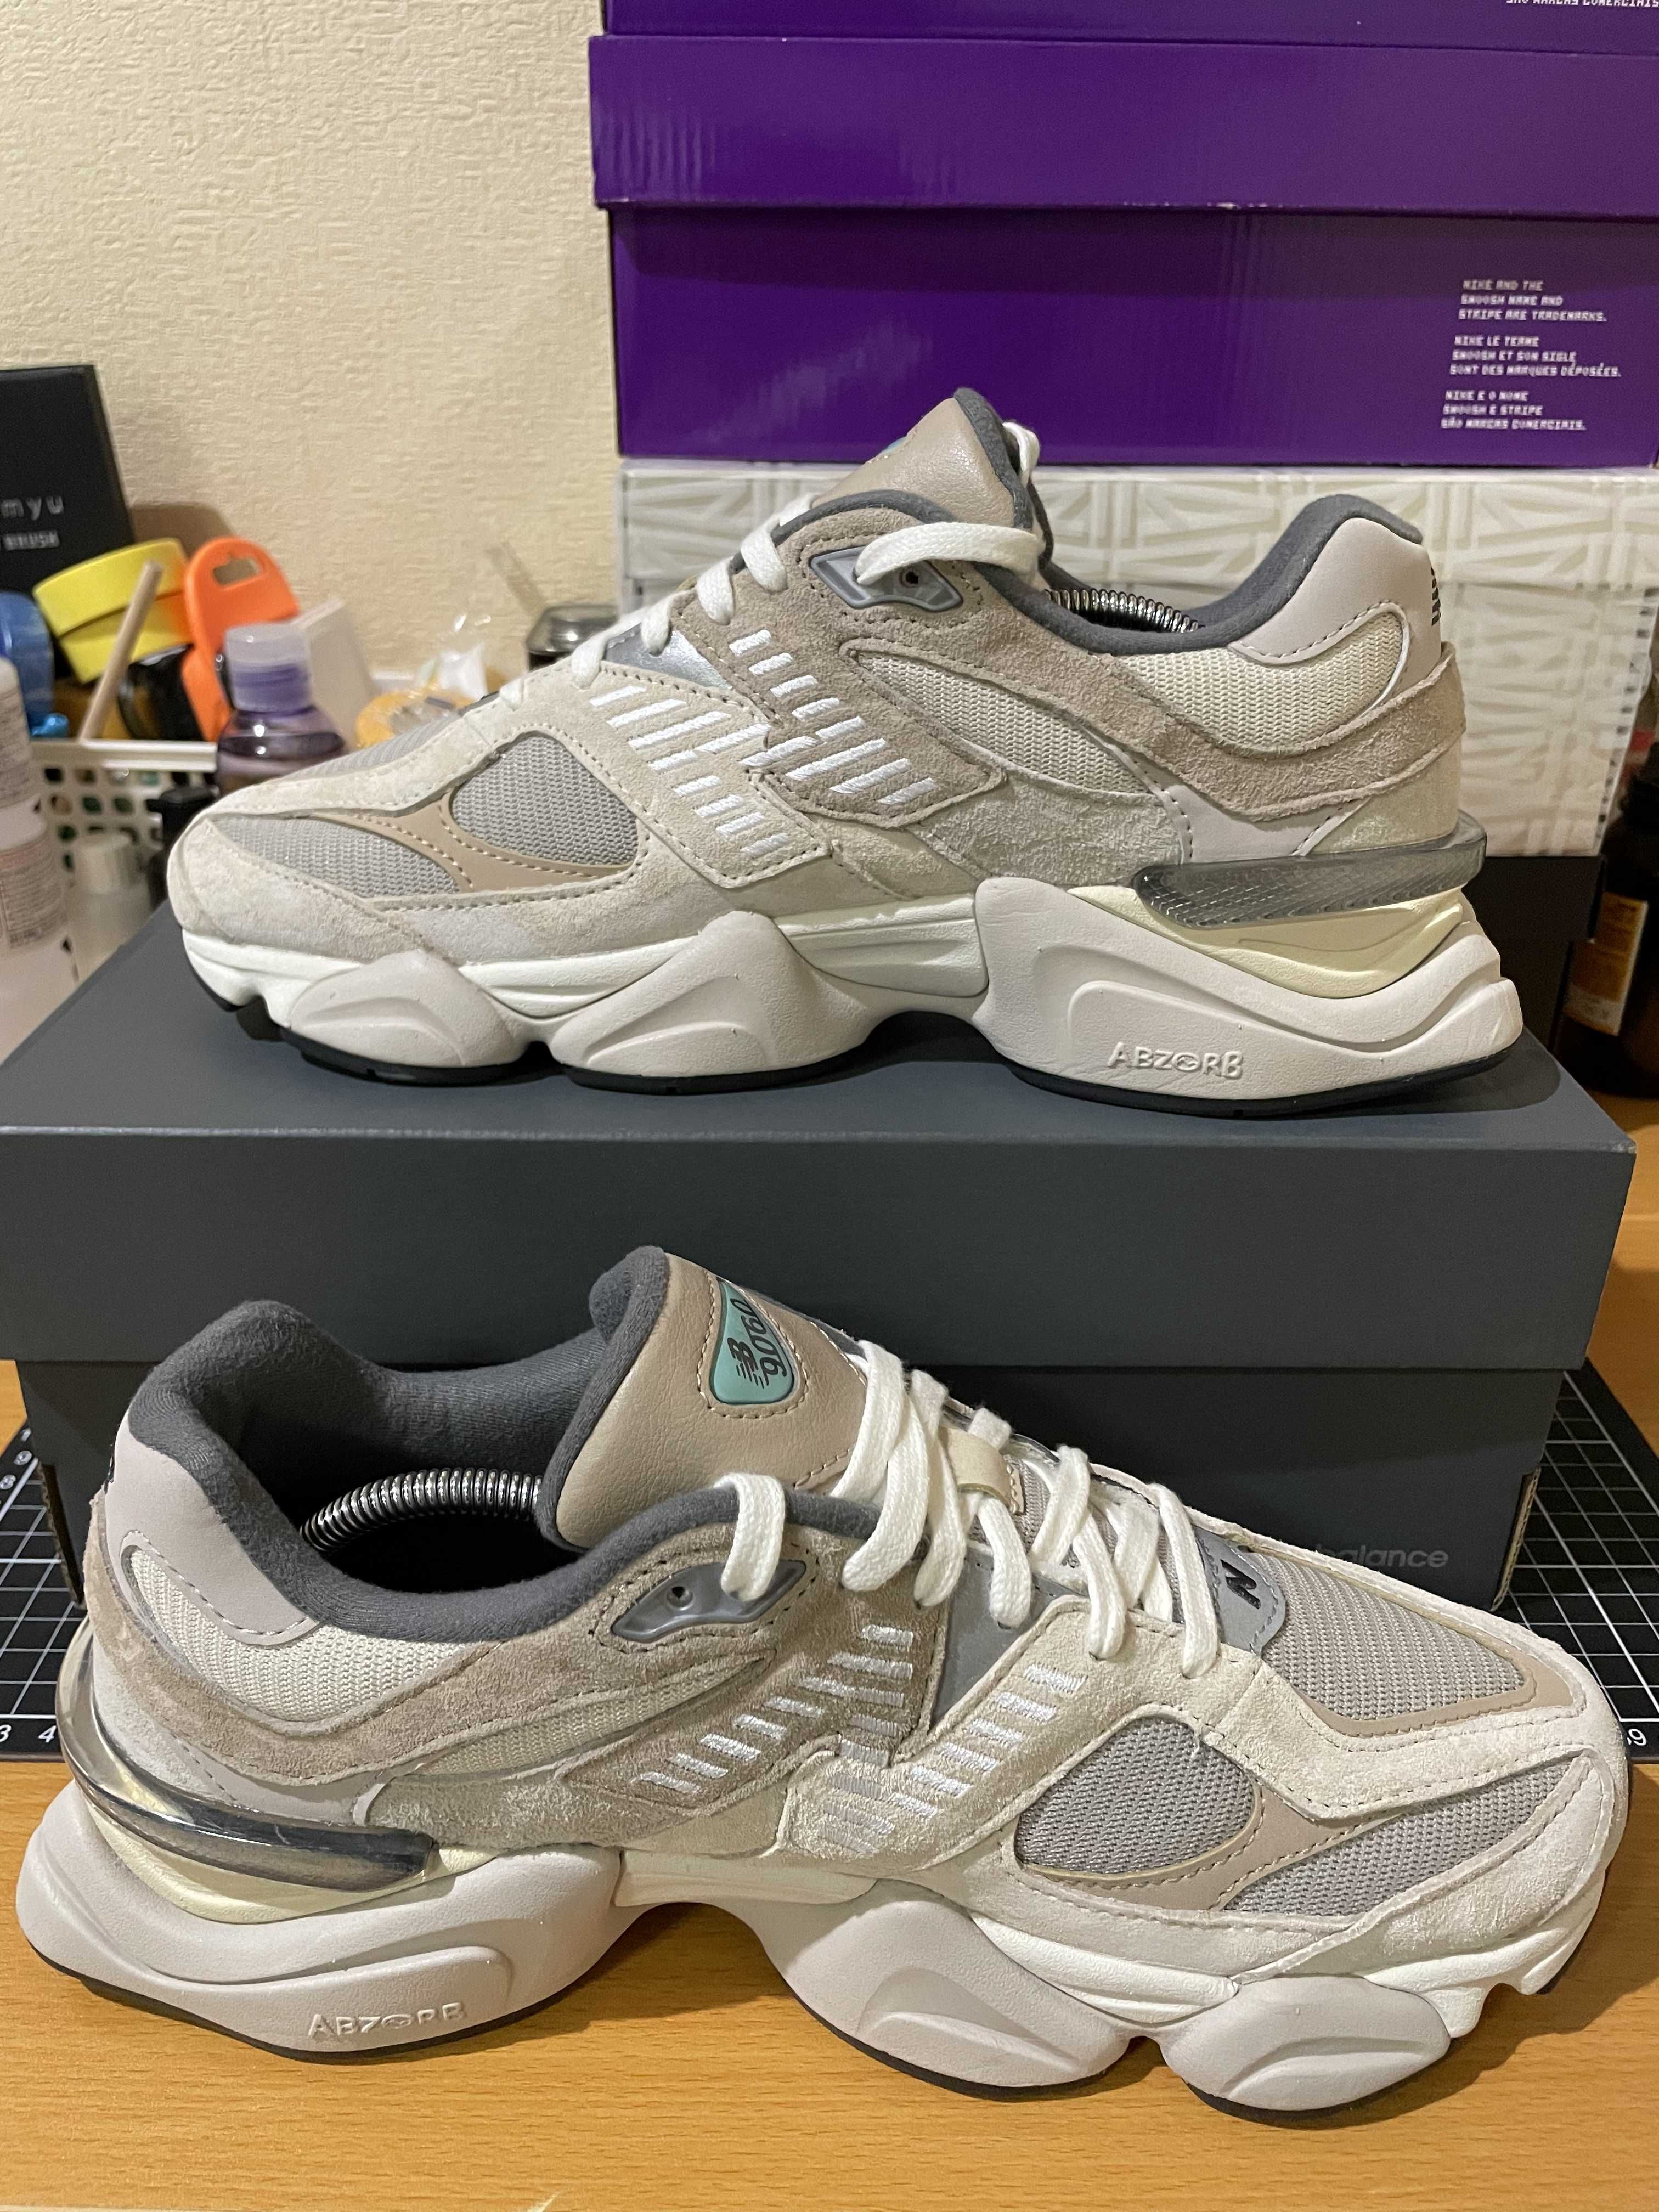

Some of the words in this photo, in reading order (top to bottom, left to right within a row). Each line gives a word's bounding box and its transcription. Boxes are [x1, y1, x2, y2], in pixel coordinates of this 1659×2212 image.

[1463, 279, 1493, 290] NIKE
[1496, 280, 1519, 290] AND
[1523, 280, 1543, 291] THE
[1458, 308, 1503, 320] STRIPE
[1454, 335, 1484, 346] NIKE
[1487, 335, 1500, 347] LE
[1499, 351, 1514, 361] ET
[1445, 390, 1475, 401] NIKE
[1107, 1042, 1244, 1080] ABZORB
[730, 1297, 787, 1386] 9060
[38, 1725, 57, 1743] 4
[1627, 1728, 1647, 1746] 9
